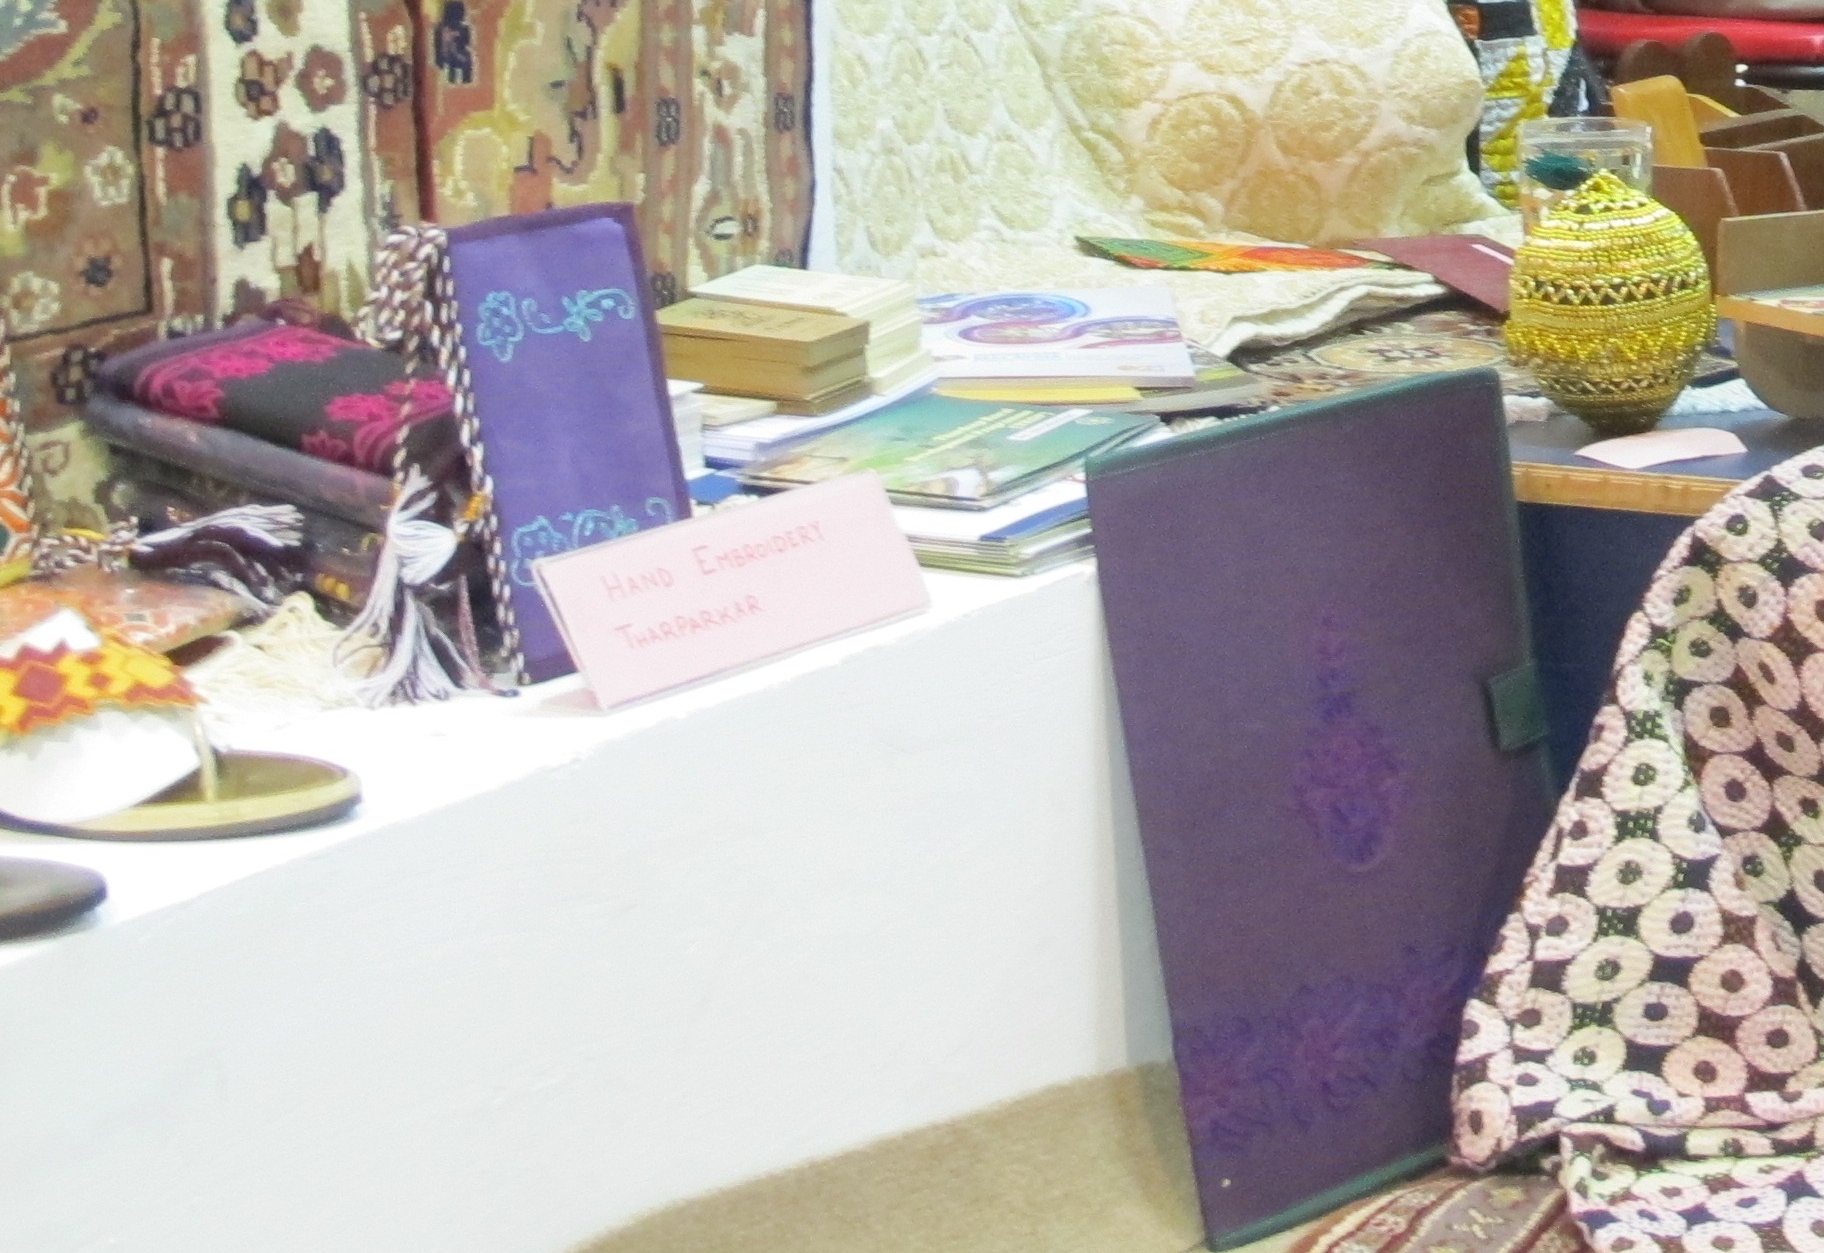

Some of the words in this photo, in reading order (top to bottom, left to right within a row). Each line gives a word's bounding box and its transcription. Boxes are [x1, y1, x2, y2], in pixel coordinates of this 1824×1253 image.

[600, 567, 675, 602] HAND
[691, 520, 825, 576] EMBROIDERY
[614, 593, 764, 650] THARPARKAR
